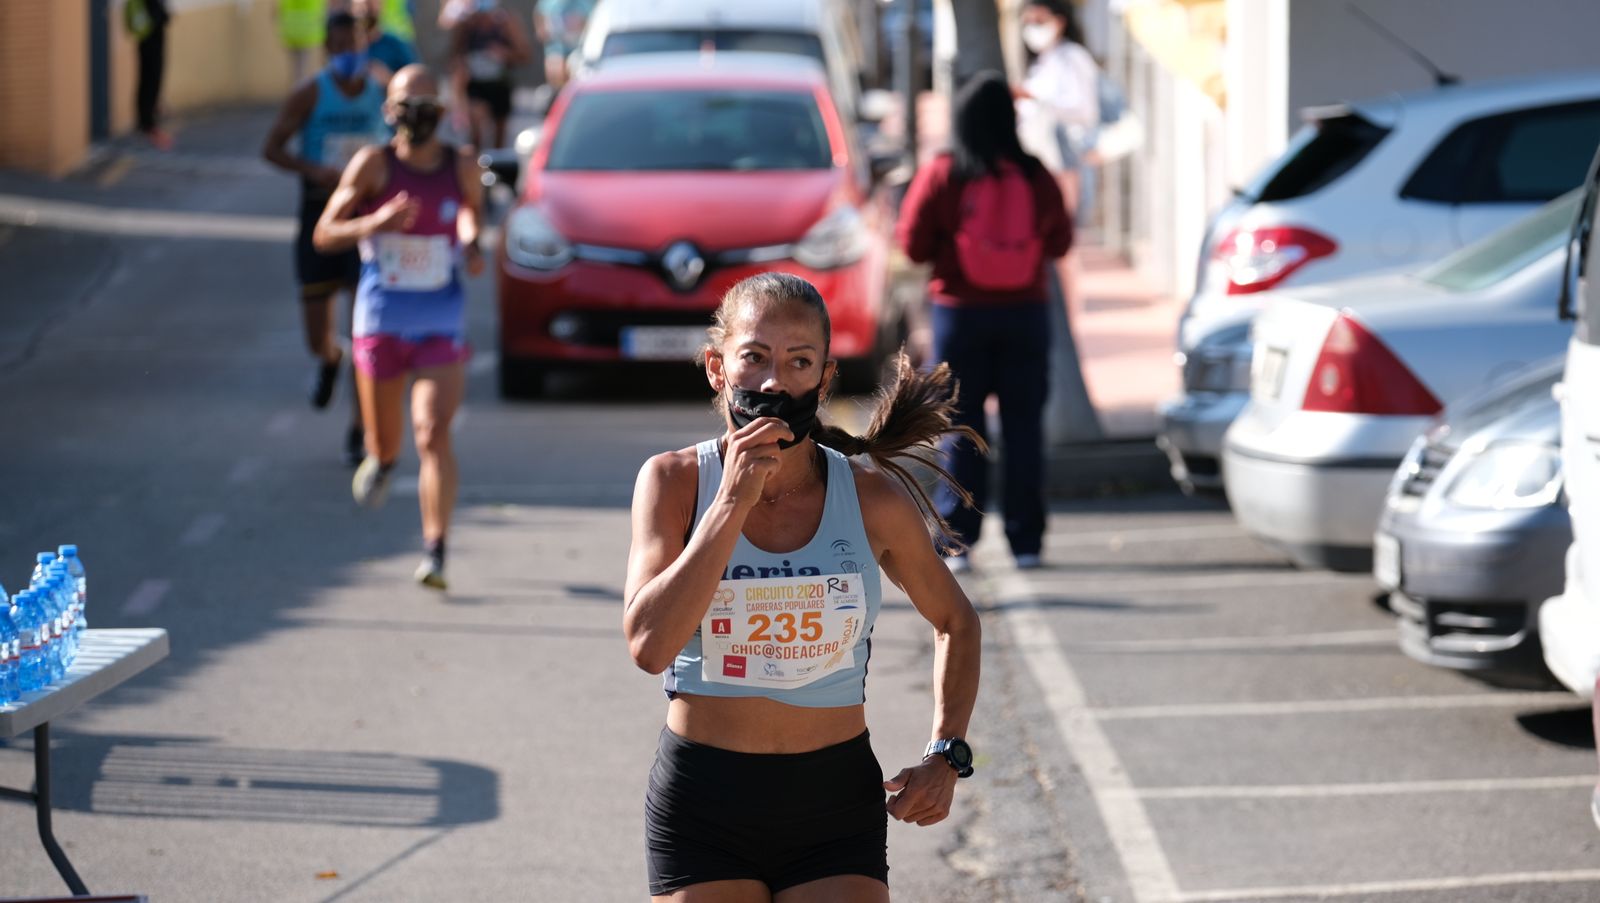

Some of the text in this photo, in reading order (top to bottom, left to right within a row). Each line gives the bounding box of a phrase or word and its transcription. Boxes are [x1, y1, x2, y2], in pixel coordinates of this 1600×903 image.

[722, 560, 821, 580] eria
[746, 583, 824, 601] CIRCUITO 2020
[746, 599, 825, 613] CARRERAS POPULARES
[717, 621, 726, 634] A
[747, 612, 823, 643] 235
[842, 616, 854, 646] RIOJA
[732, 640, 839, 660] CHIC@SDEACERO
